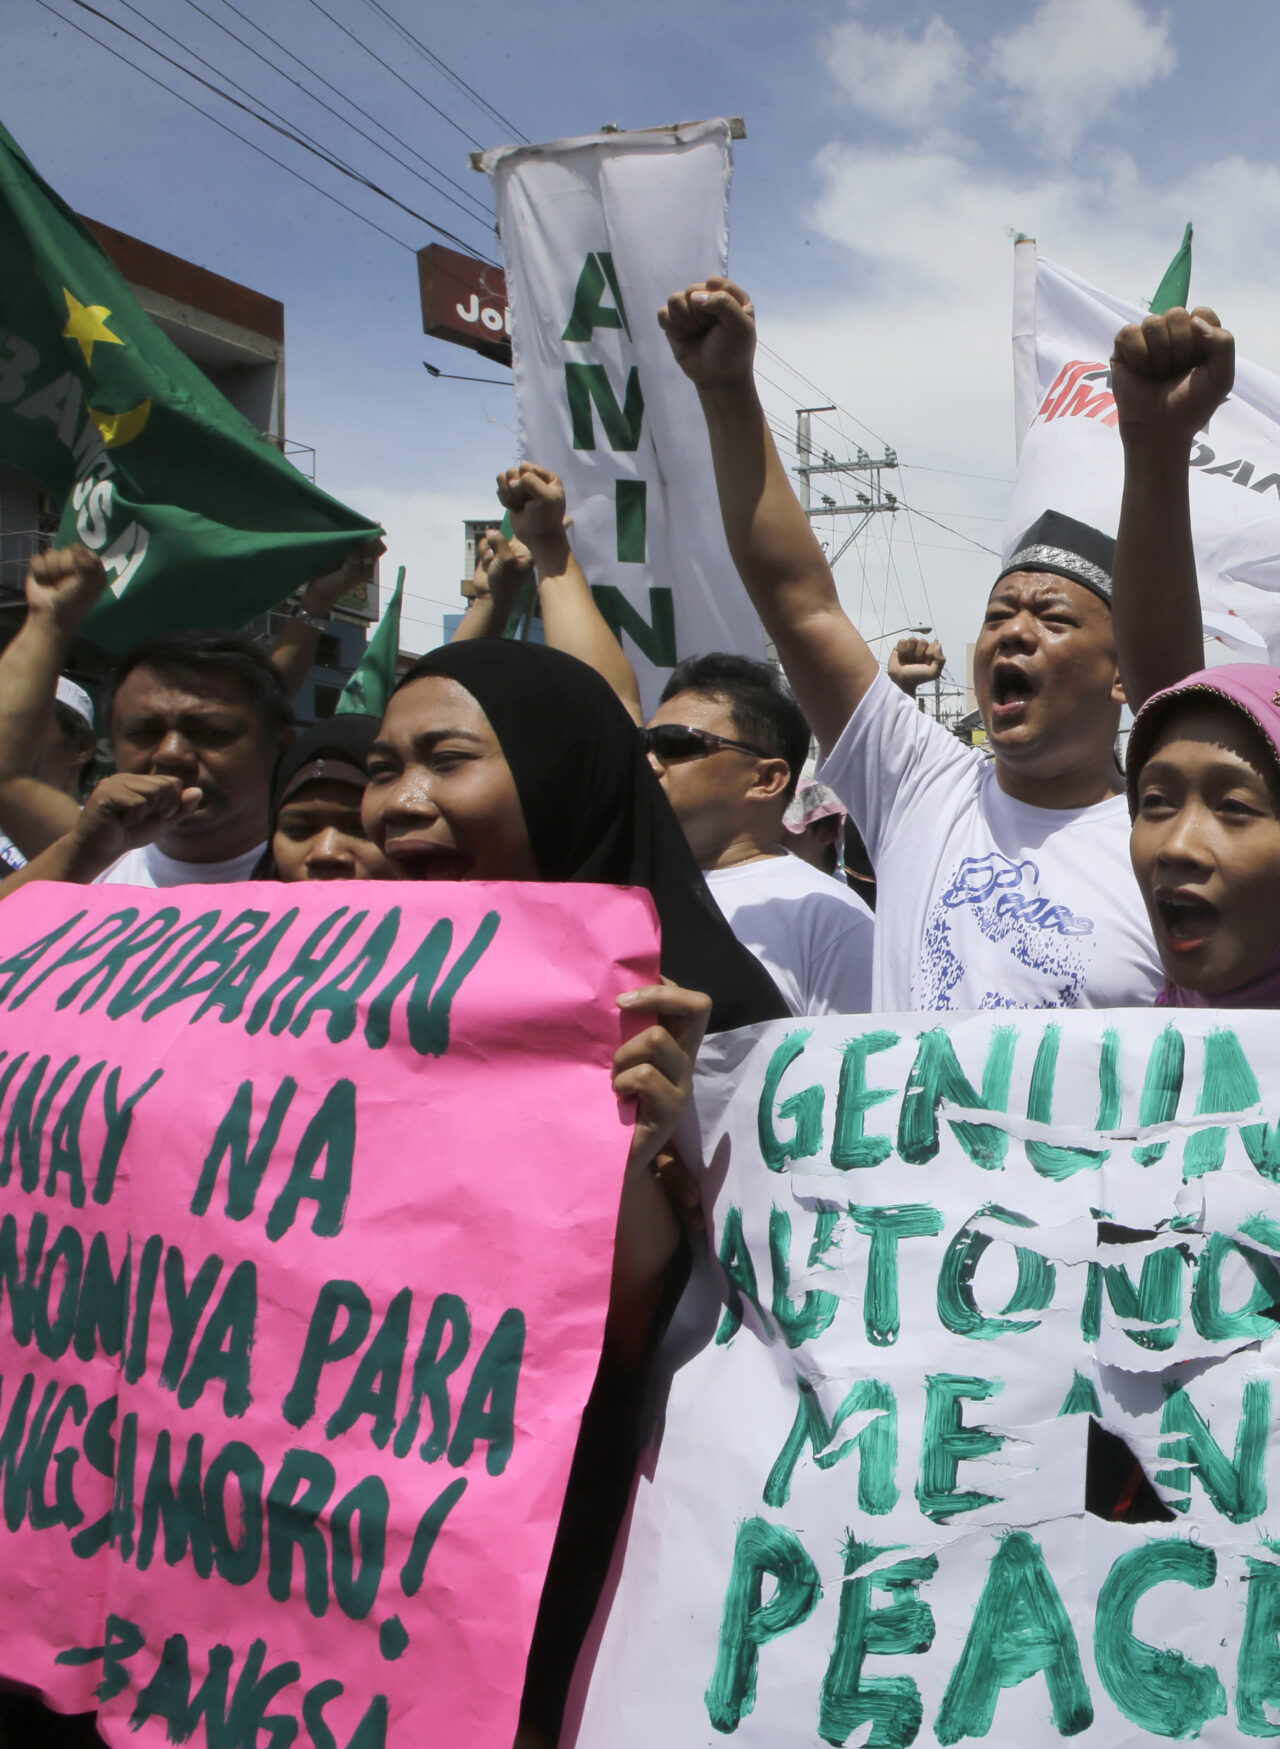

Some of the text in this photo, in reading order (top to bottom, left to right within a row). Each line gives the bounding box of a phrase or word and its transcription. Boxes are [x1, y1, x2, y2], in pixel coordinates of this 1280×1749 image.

[942, 851, 1095, 937] Peace
[190, 1075, 357, 1241] NA
[283, 1278, 526, 1476] PARA
